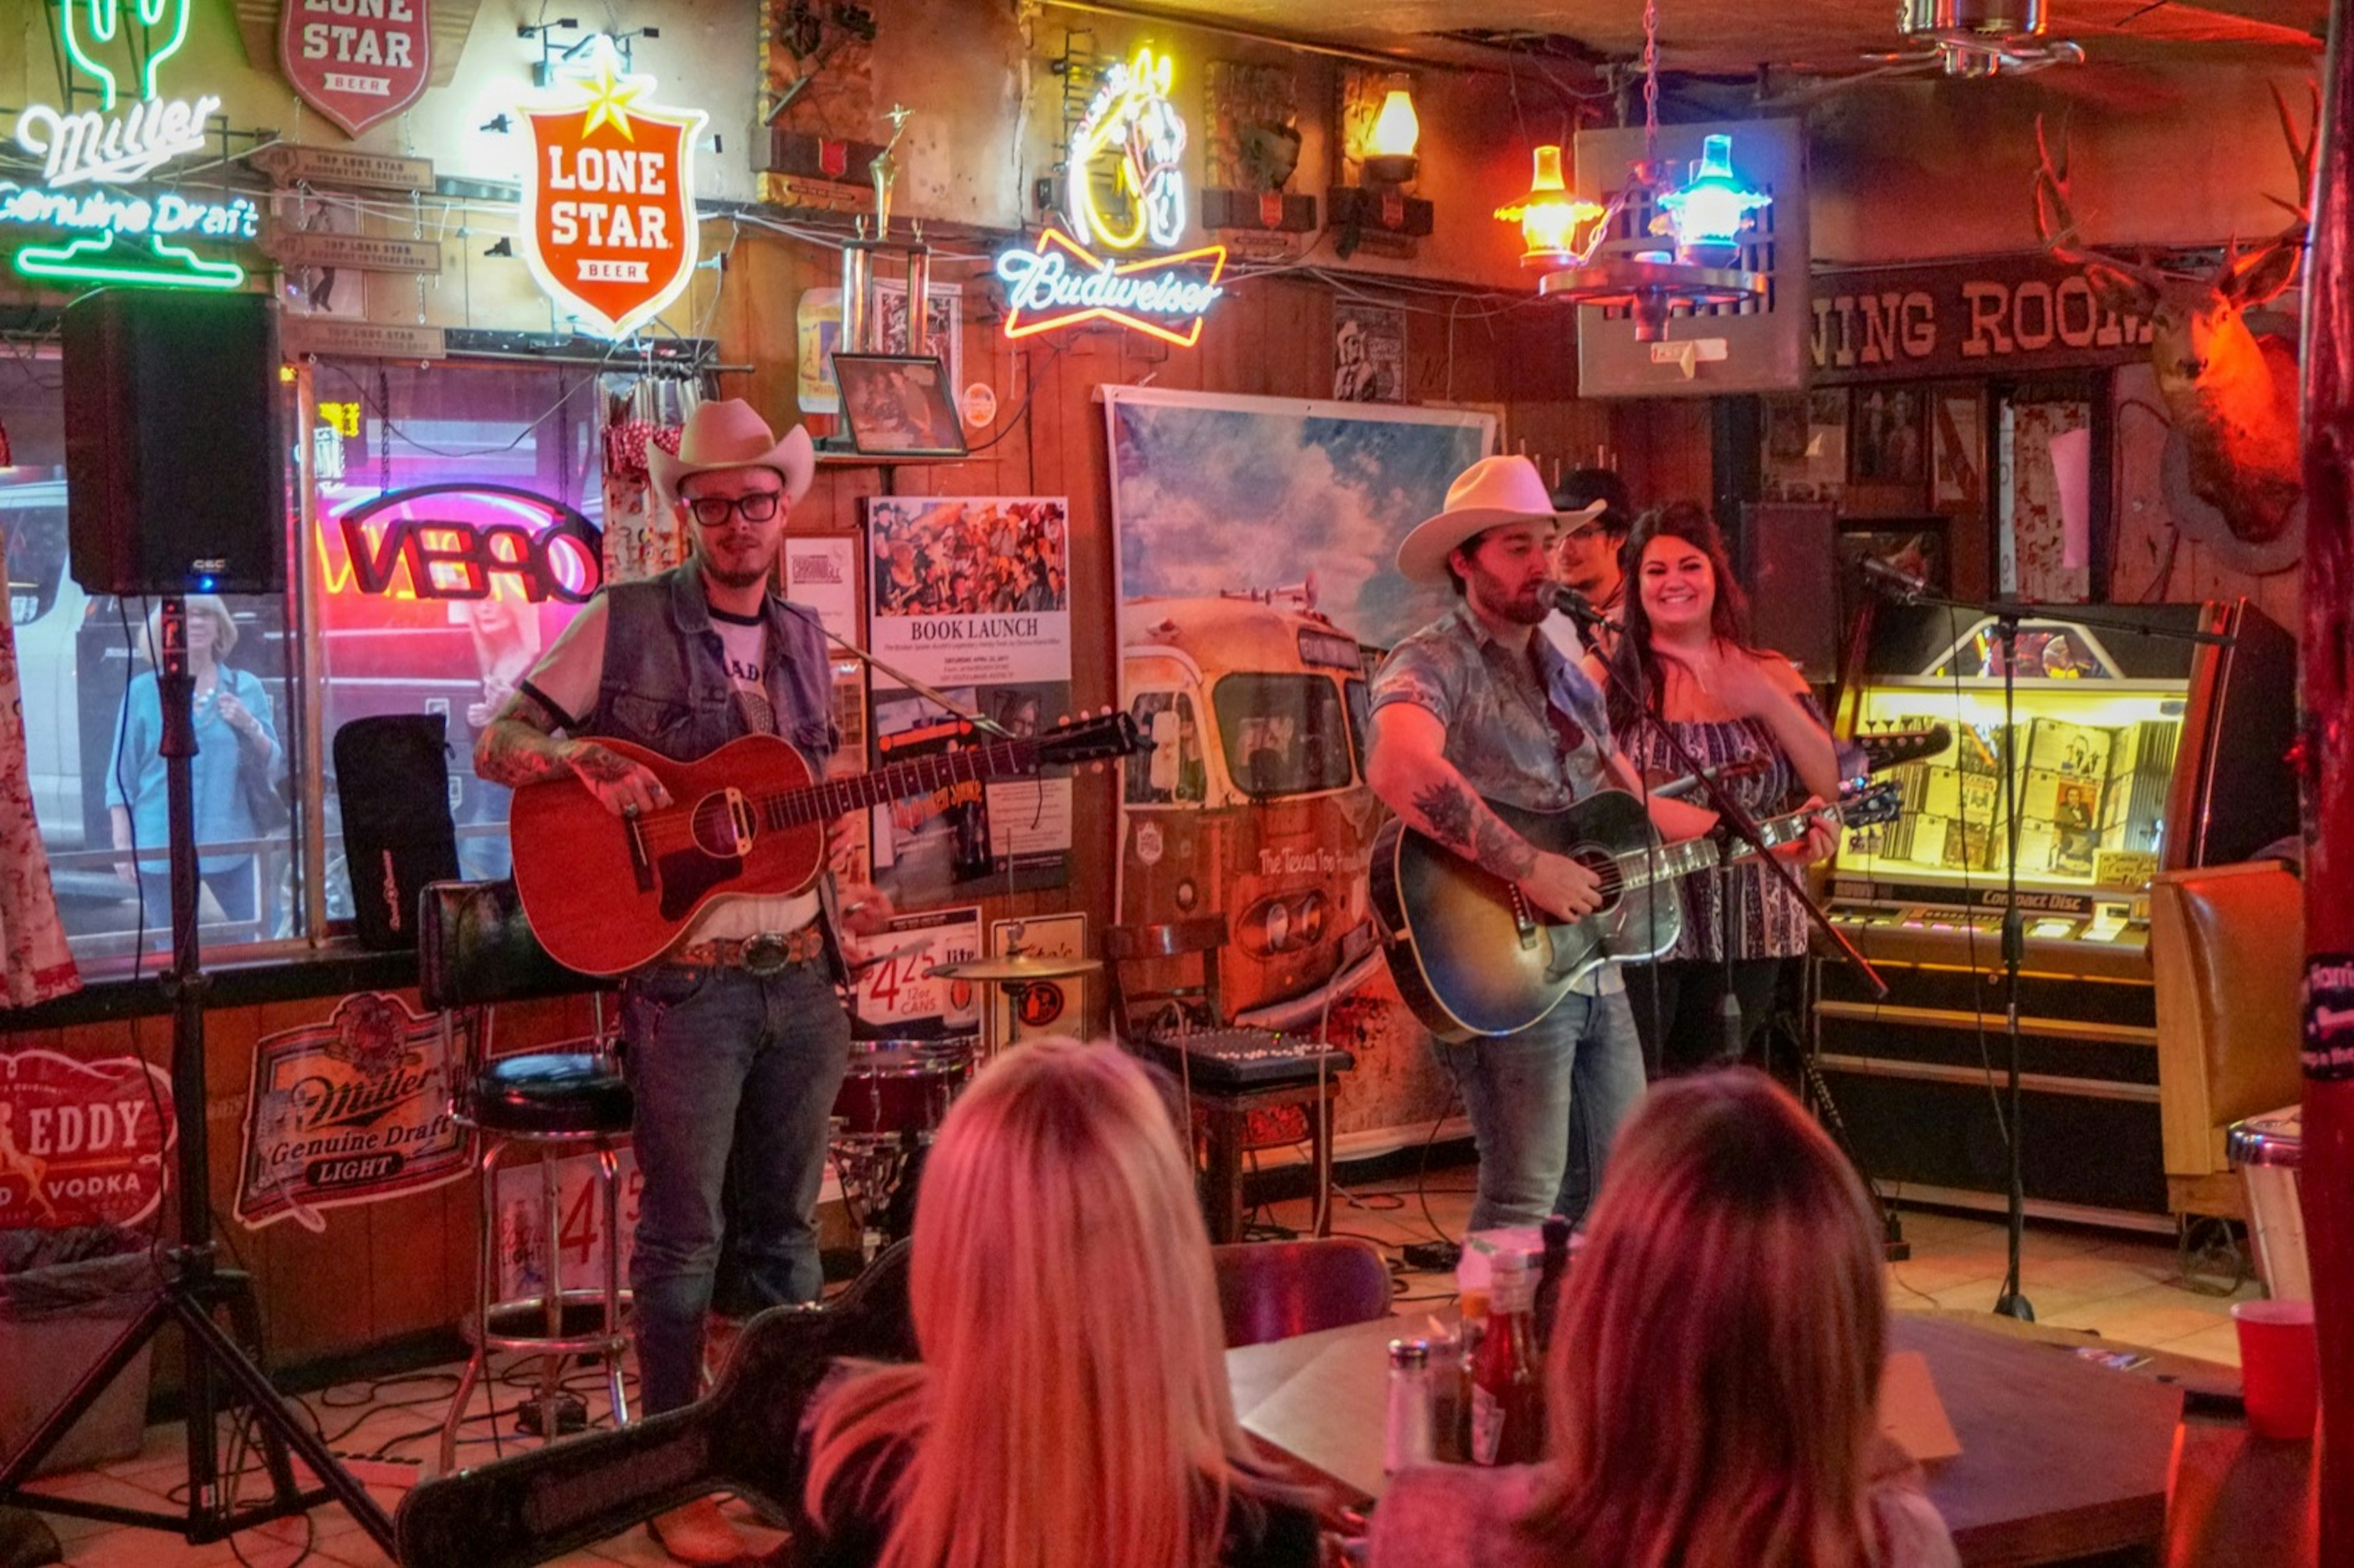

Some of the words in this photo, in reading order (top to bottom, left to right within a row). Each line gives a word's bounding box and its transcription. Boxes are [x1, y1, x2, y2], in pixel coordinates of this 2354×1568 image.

[303, 25, 413, 68] STAR
[334, 77, 384, 93] BEER
[17, 95, 222, 188] Miller
[549, 145, 666, 195] LONE
[153, 194, 260, 237] Draft
[552, 201, 669, 249] STAR
[589, 264, 638, 278] BEER
[997, 249, 1223, 313] Budweiser
[912, 621, 962, 640] BOOK
[969, 618, 1038, 638] LAUNCH
[2048, 895, 2082, 910] Disc
[901, 998, 937, 1015] CANS
[291, 1068, 438, 1132] Miller
[29, 1099, 145, 1155] EDDY
[272, 1132, 378, 1165] Genuine
[384, 1114, 452, 1147] Draft
[48, 1173, 140, 1199] VODKA
[318, 1156, 394, 1182] LIGHT
